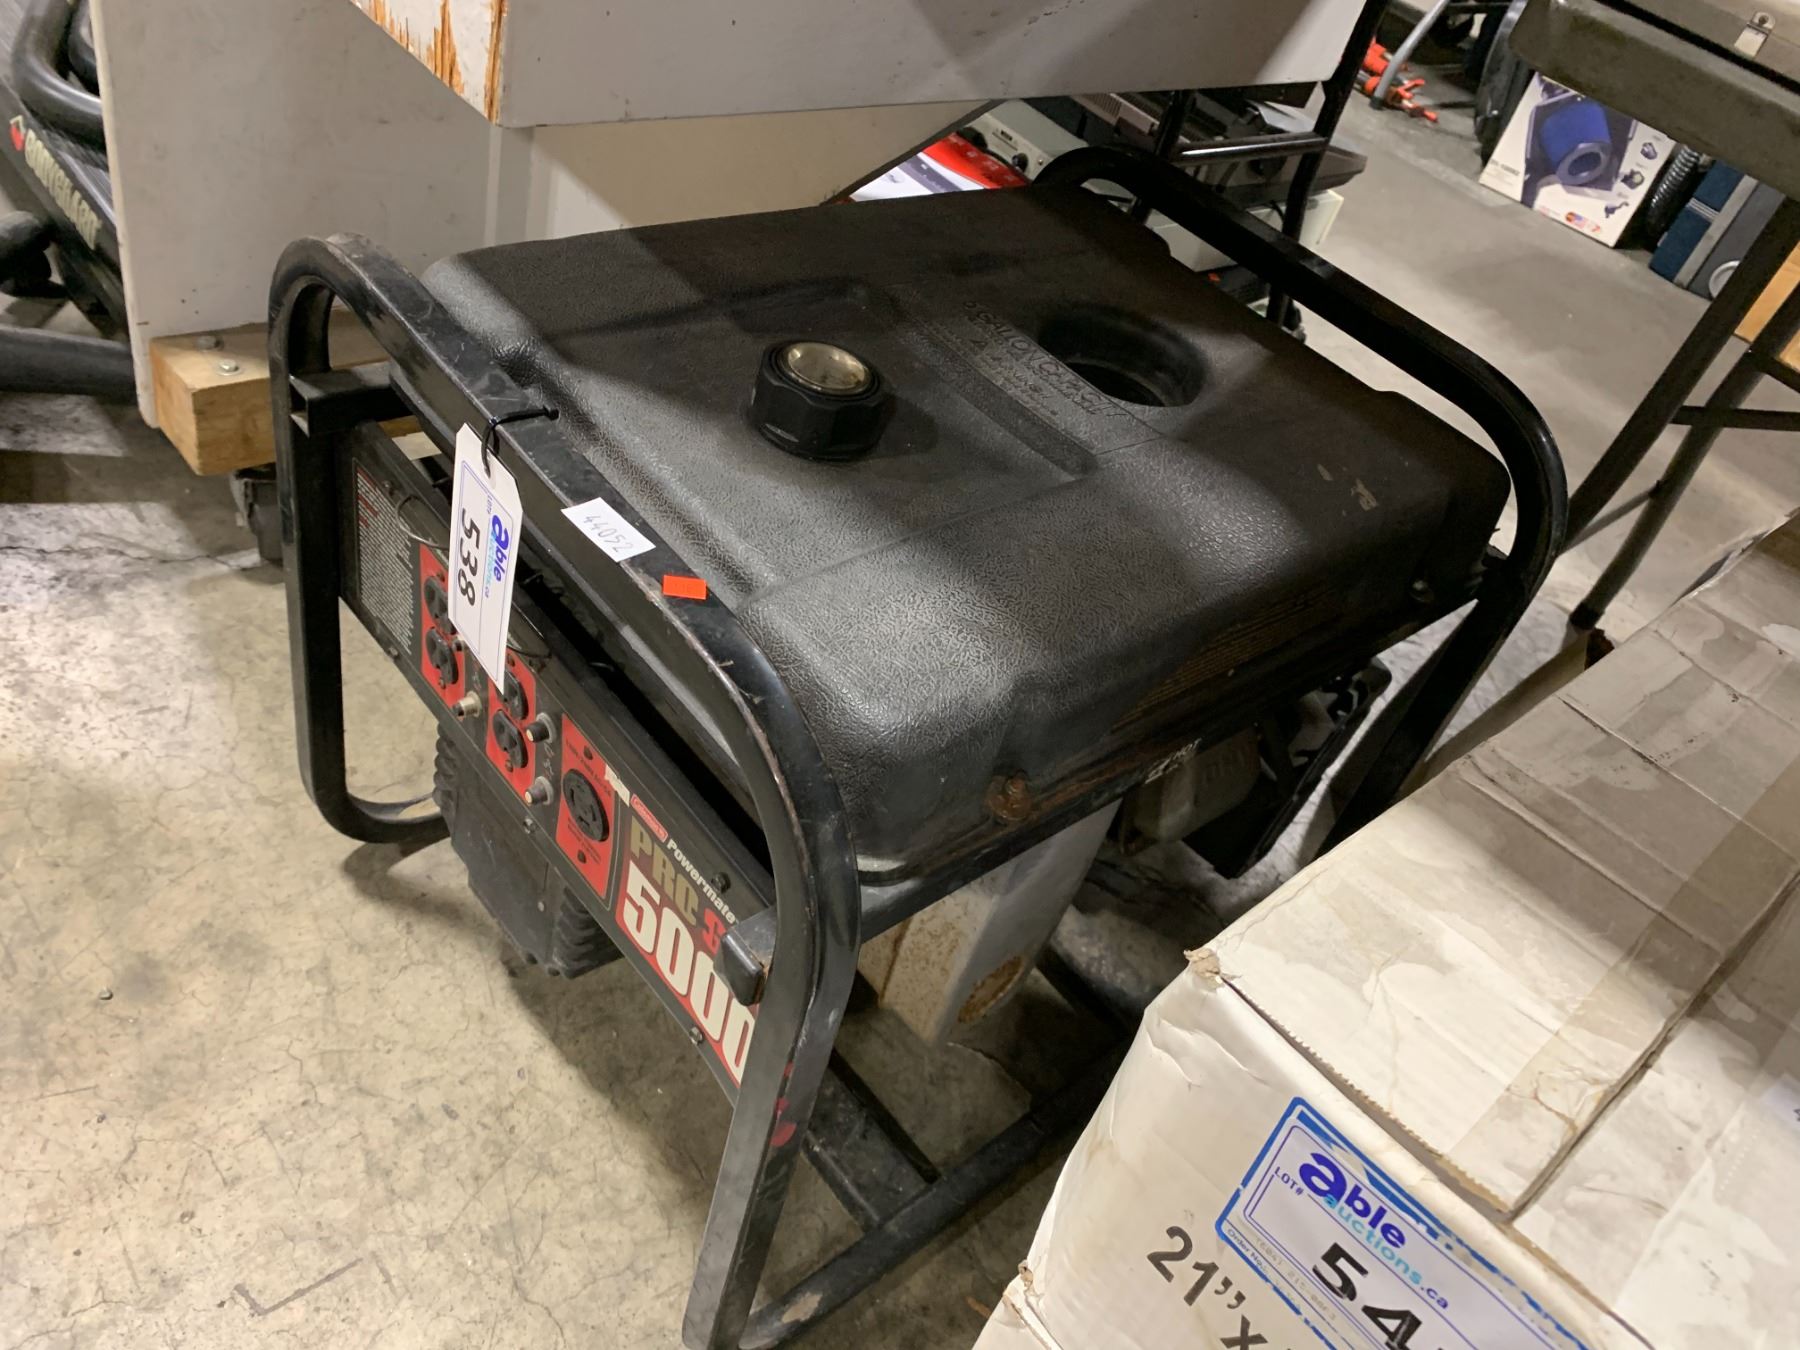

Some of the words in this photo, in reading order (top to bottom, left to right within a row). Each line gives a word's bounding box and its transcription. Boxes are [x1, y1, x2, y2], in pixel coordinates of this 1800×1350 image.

[457, 507, 481, 607] 538
[491, 514, 510, 582] able
[583, 515, 634, 553] 44052
[666, 838, 737, 924] Powermate
[623, 859, 756, 1085] 5000
[1274, 1166, 1304, 1196] LOT#
[1299, 1152, 1406, 1249] able
[1312, 1242, 1445, 1350] 54
[1322, 1194, 1449, 1310] auctions.ca
